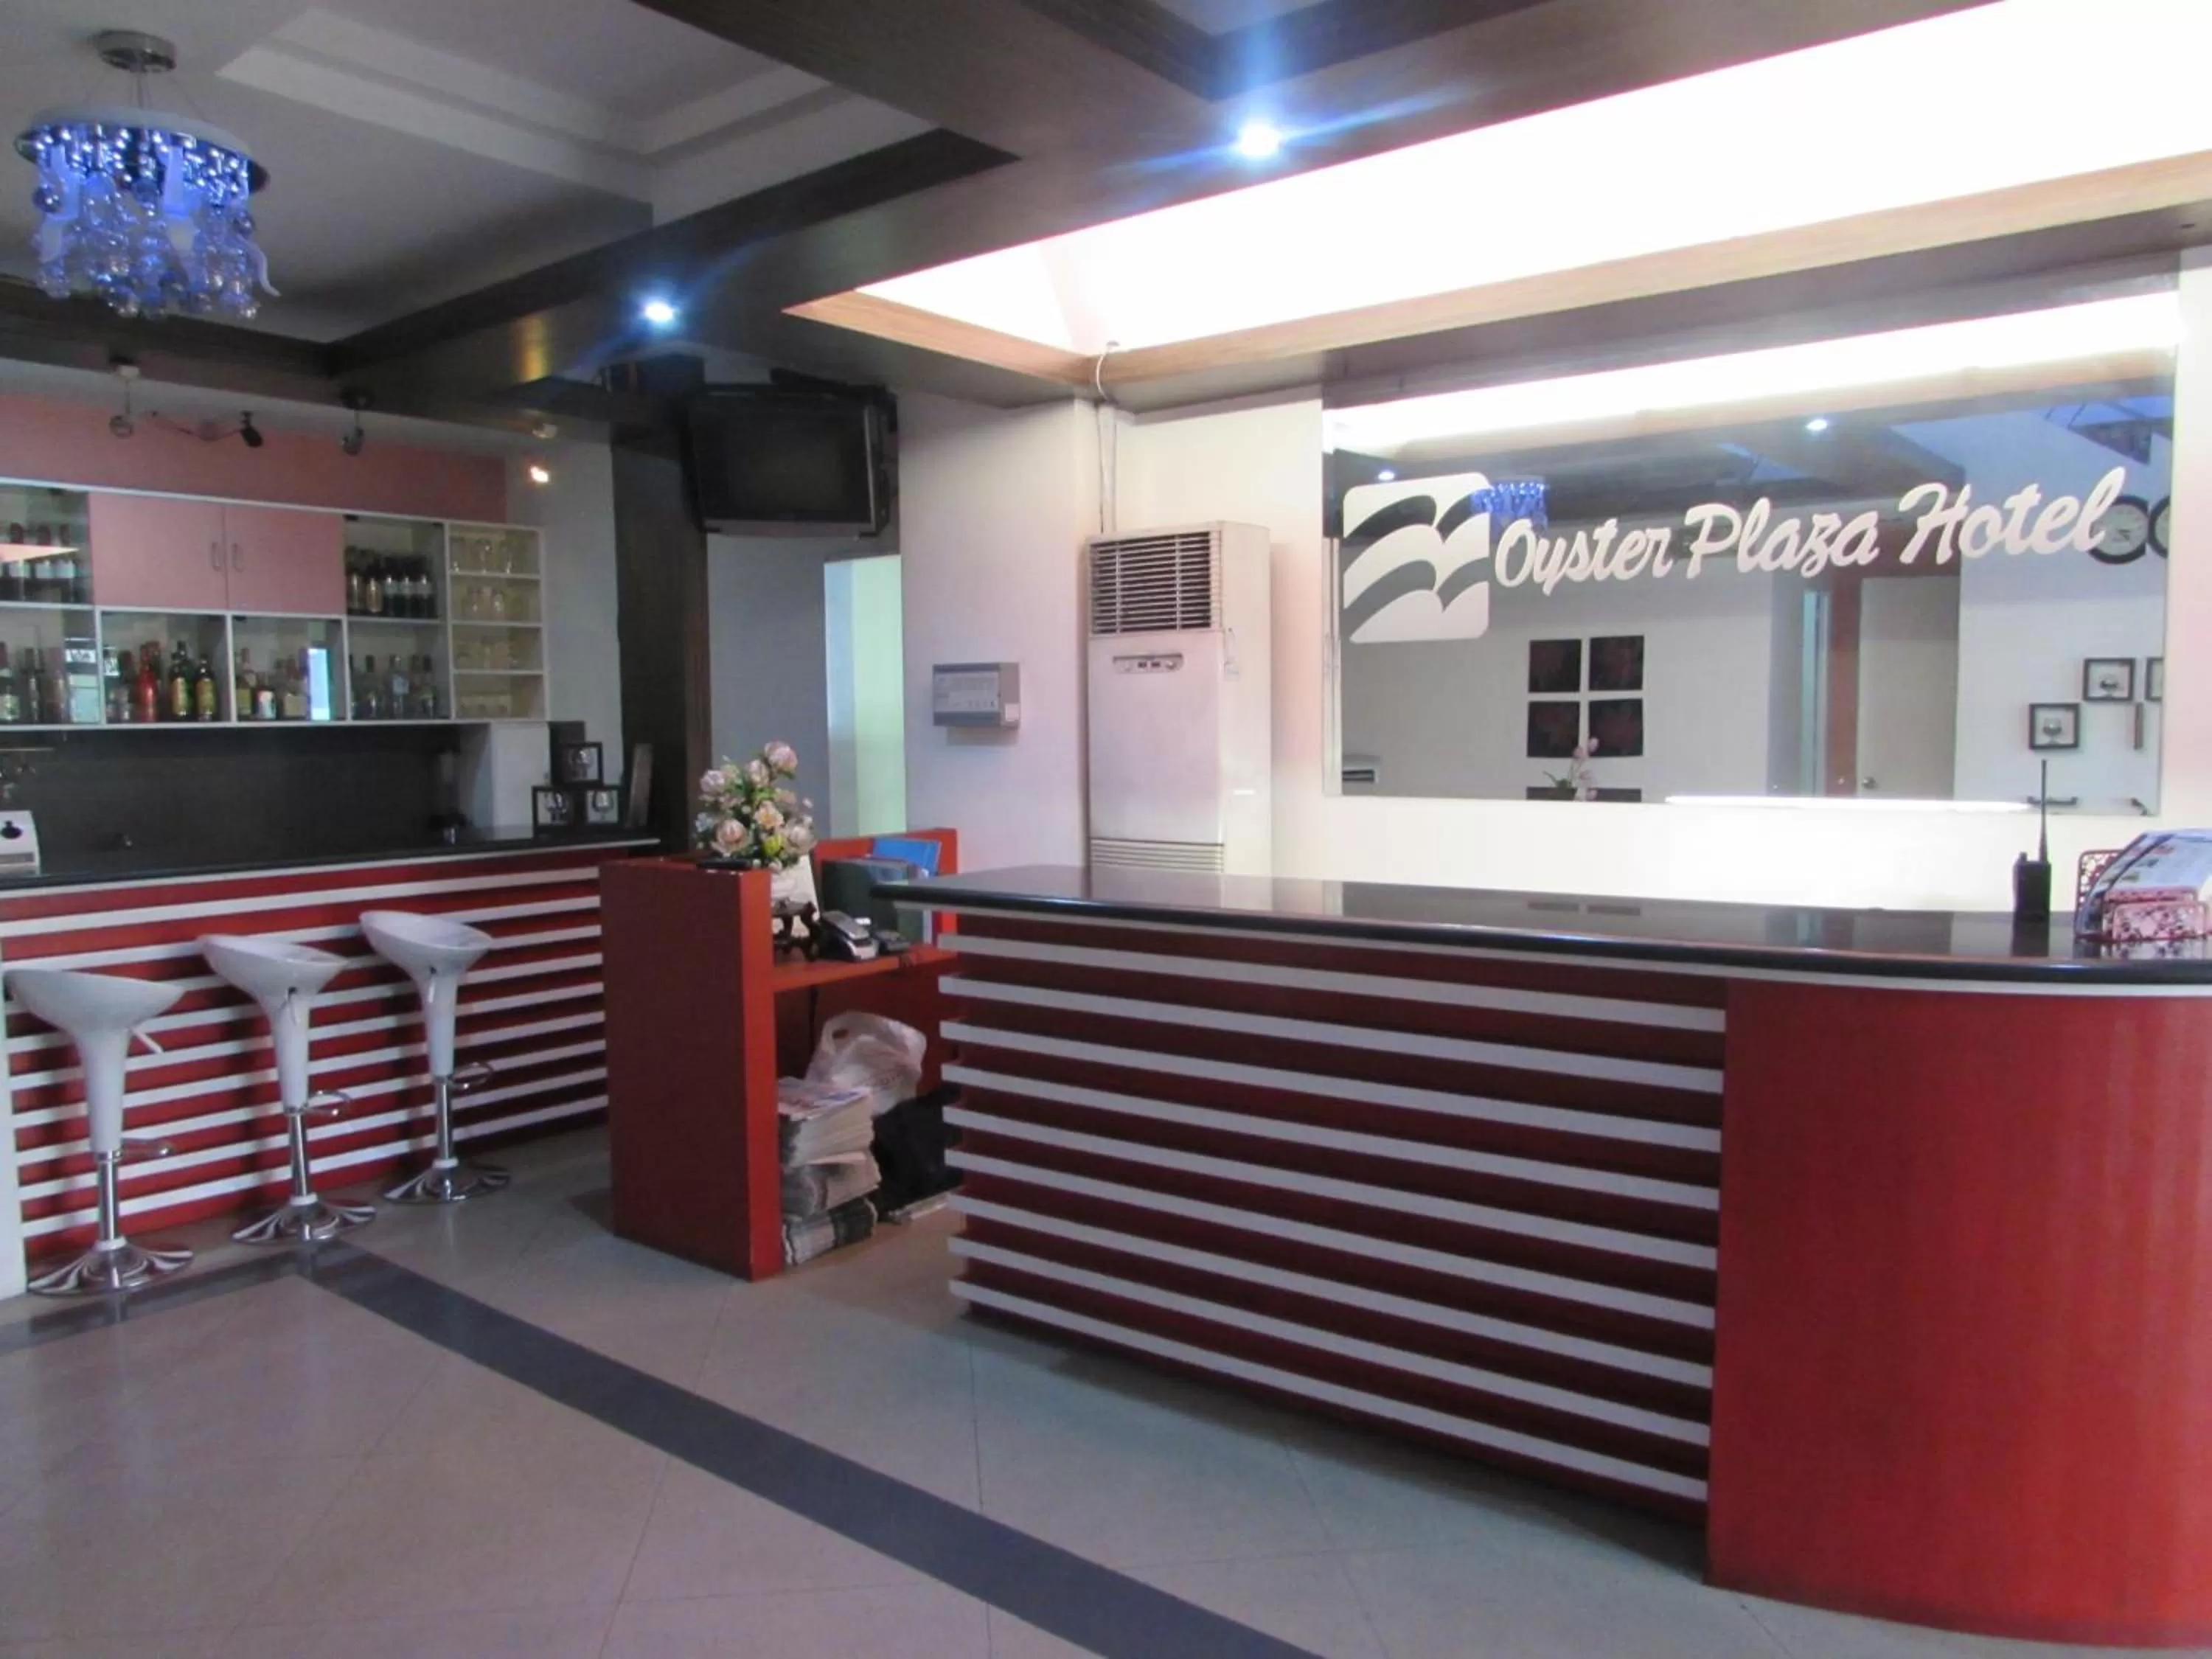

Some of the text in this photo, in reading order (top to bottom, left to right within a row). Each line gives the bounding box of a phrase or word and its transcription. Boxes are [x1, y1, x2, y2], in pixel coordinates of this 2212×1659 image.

[1495, 467, 2126, 595] Oyster Plaza Hotel
